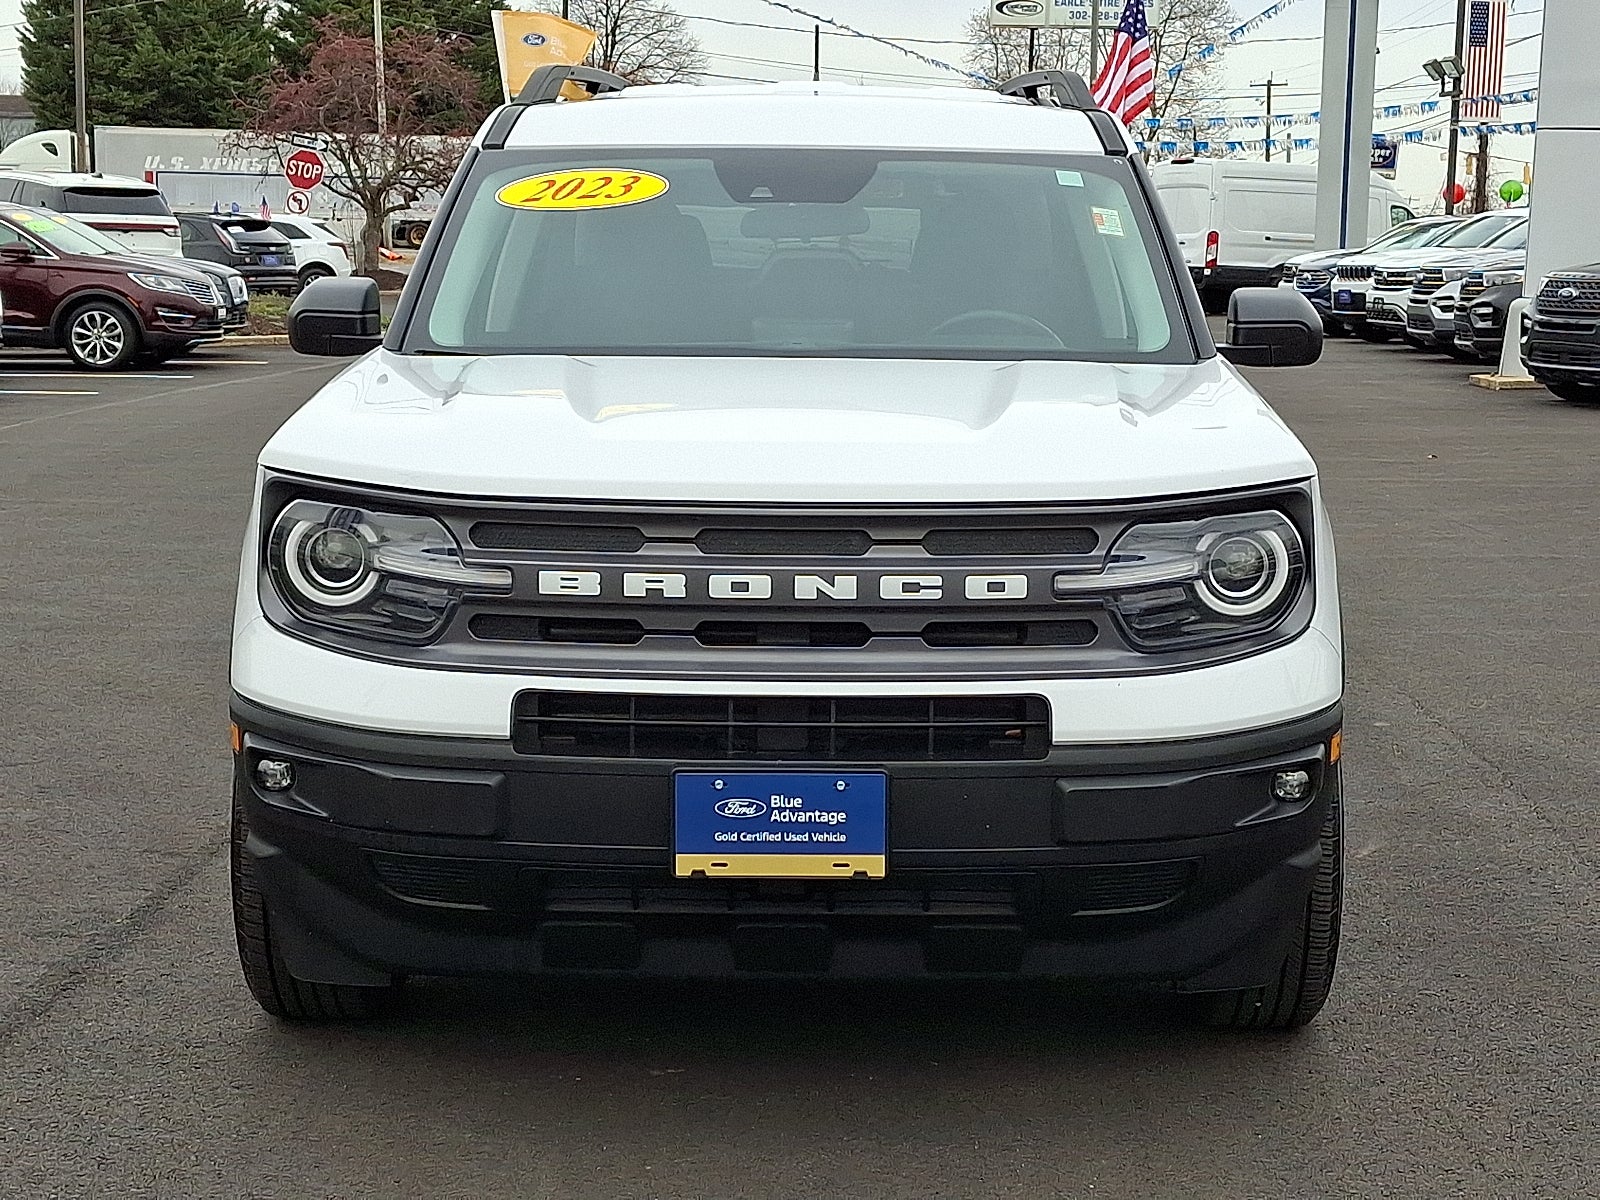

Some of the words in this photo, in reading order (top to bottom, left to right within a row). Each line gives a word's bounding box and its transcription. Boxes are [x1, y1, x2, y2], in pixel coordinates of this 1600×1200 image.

[144, 155, 190, 170] U.S.
[287, 160, 322, 180] STOP
[520, 175, 641, 203] 2023
[538, 570, 1028, 600] BRONCO
[770, 795, 803, 808] Blue
[770, 809, 847, 825] Advantage
[714, 831, 738, 842] Gold
[740, 831, 782, 842] Certified
[784, 831, 809, 842] Used
[811, 832, 847, 843] Vehicle
